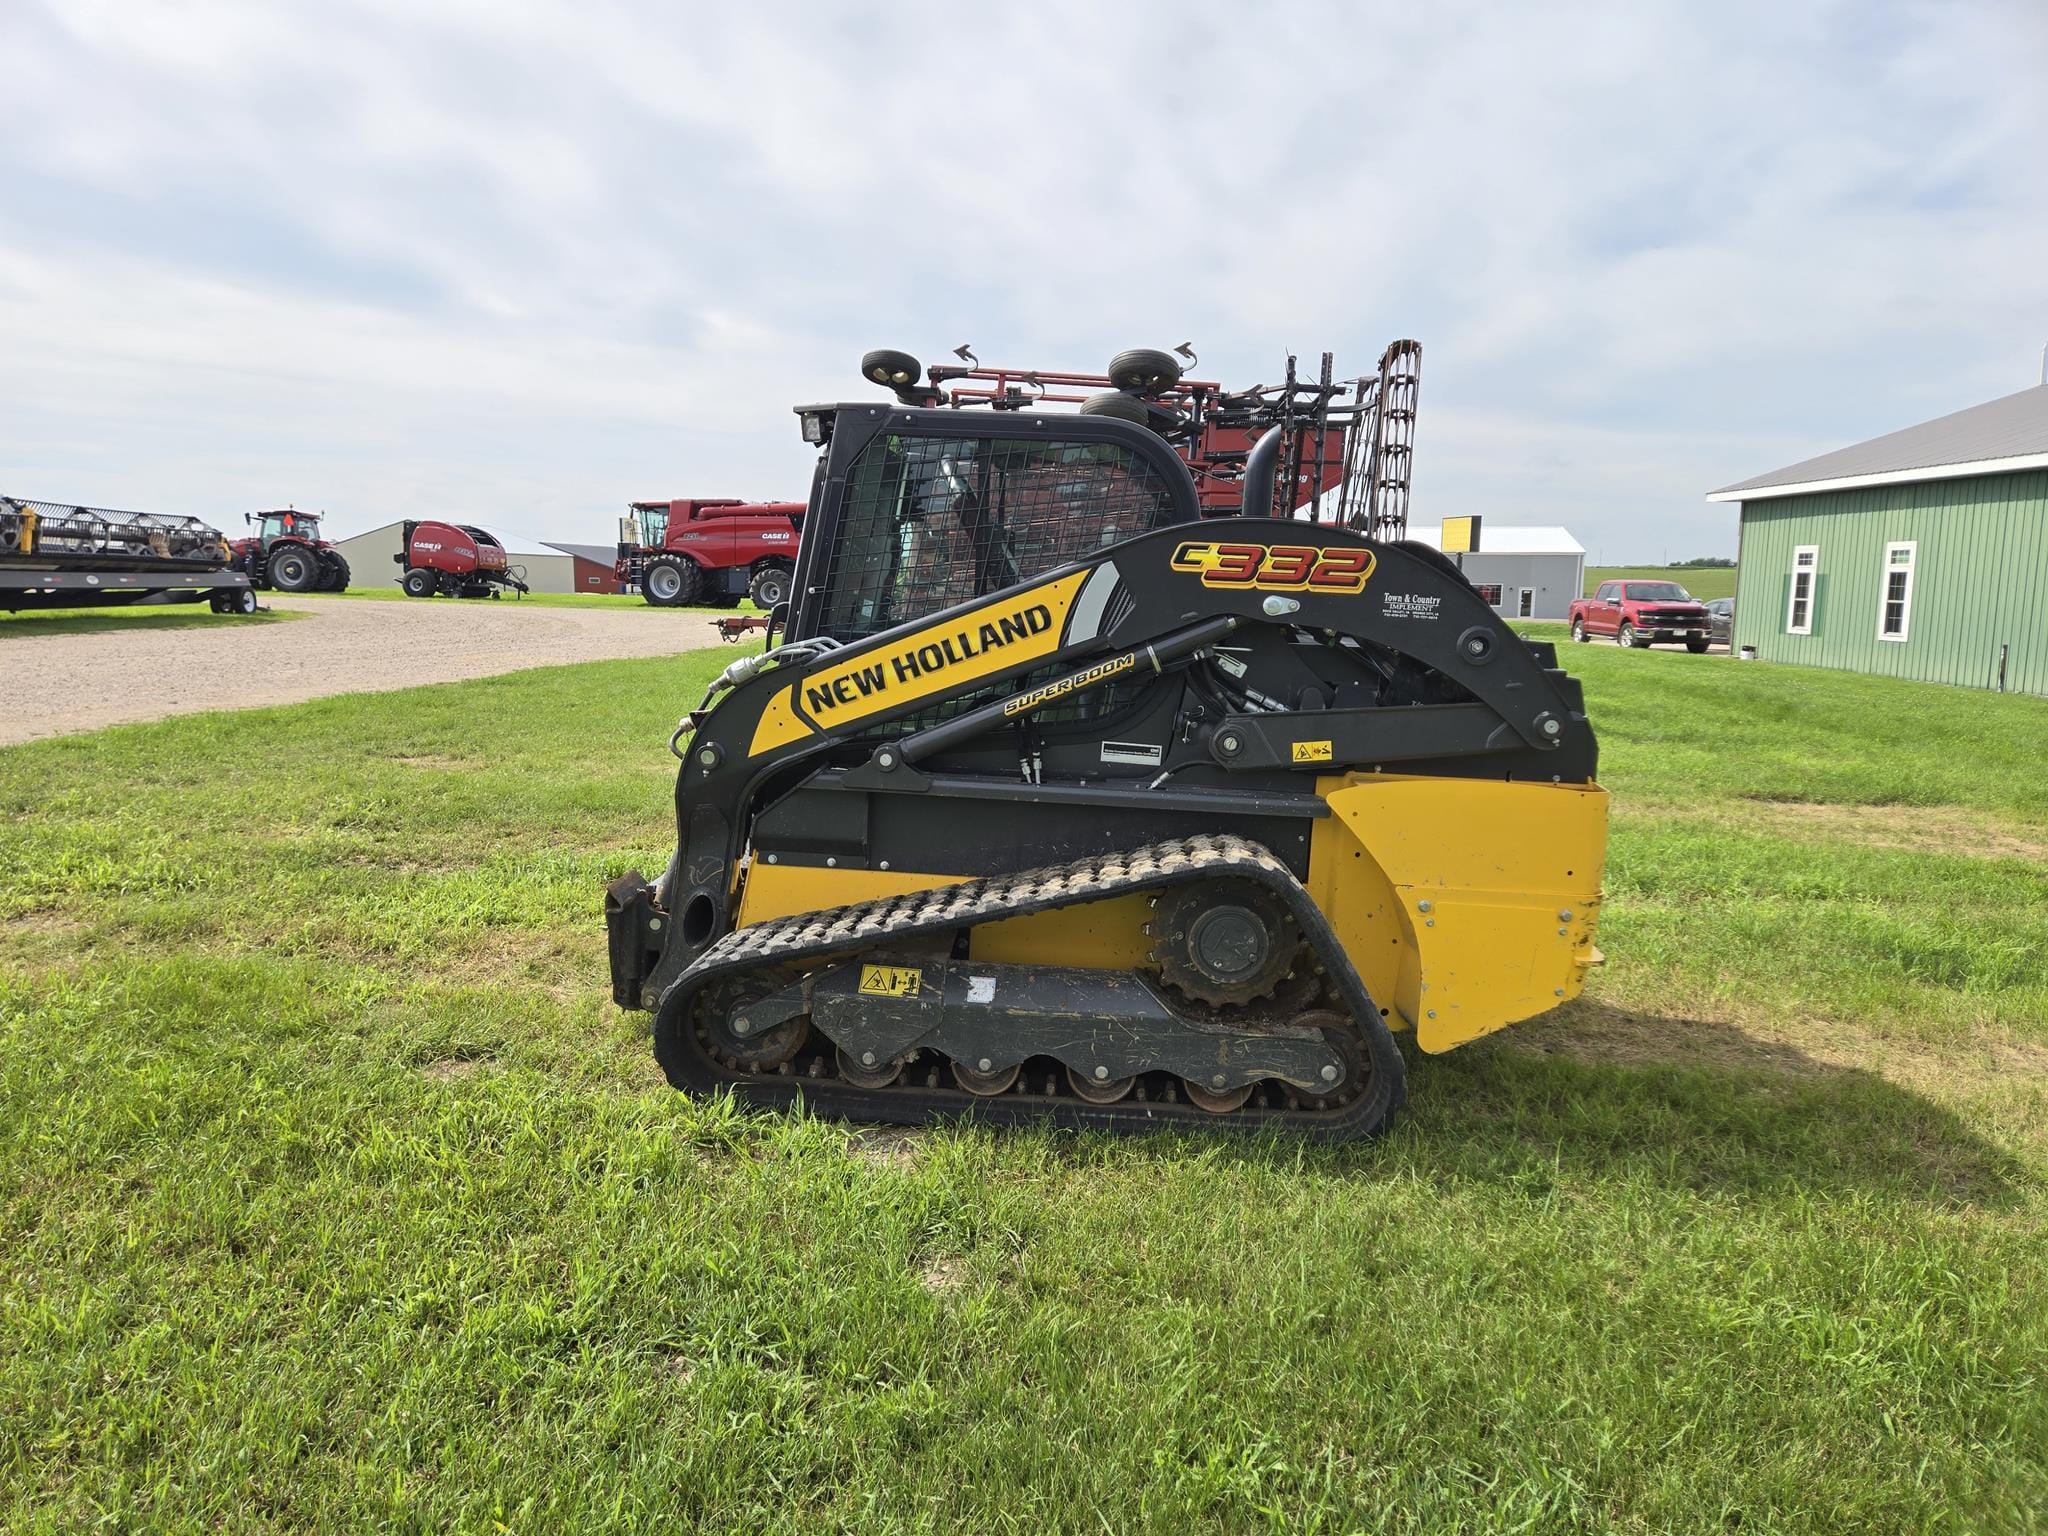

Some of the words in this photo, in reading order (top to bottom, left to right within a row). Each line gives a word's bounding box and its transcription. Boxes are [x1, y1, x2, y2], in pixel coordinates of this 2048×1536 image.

[1171, 542, 1376, 594] C332
[1384, 592, 1403, 602] Town
[1404, 594, 1411, 603] &
[1412, 594, 1441, 606] Country
[1390, 603, 1434, 612] IMPLEMENT
[806, 663, 887, 714] NEW
[891, 604, 1052, 683] HOLLAND
[1004, 678, 1073, 715] SUPER
[1074, 653, 1135, 688] BOOM
